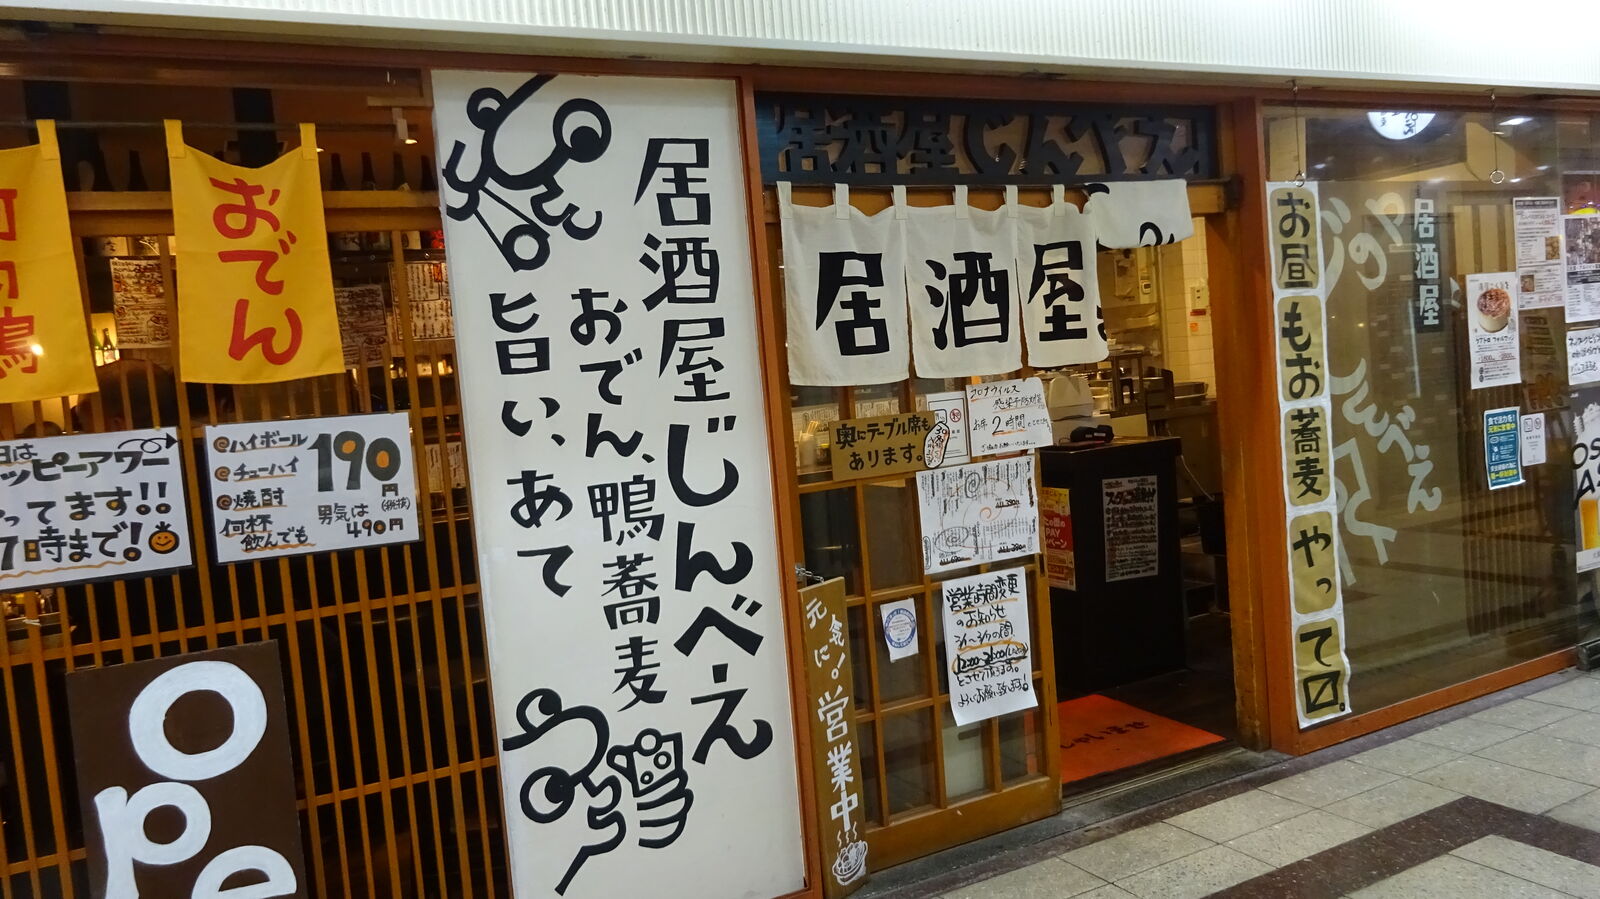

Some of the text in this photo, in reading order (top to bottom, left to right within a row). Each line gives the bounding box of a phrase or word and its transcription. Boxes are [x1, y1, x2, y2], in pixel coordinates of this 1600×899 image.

[209, 177, 303, 366] おでん
[1414, 198, 1440, 326] 居酒屋
[815, 240, 1088, 357] 居酒屋
[970, 384, 1020, 399] コロナウイルス
[229, 431, 309, 453] ハイボール
[488, 291, 574, 598] 旨い、あて
[835, 414, 931, 450] 奥にテーブル席も
[307, 430, 401, 497] 190 円
[633, 137, 774, 765] 居酒屋じんべえ
[849, 443, 923, 471] あります。
[233, 456, 300, 480] チューハイ
[233, 487, 285, 509] 焼酎
[220, 514, 273, 536] 何杯
[318, 503, 370, 525] 男気は
[346, 517, 404, 538] 490円
[241, 525, 309, 551] 飲んでも
[946, 573, 1020, 612] 営業時間変更
[956, 604, 1008, 629] のお知らせ
